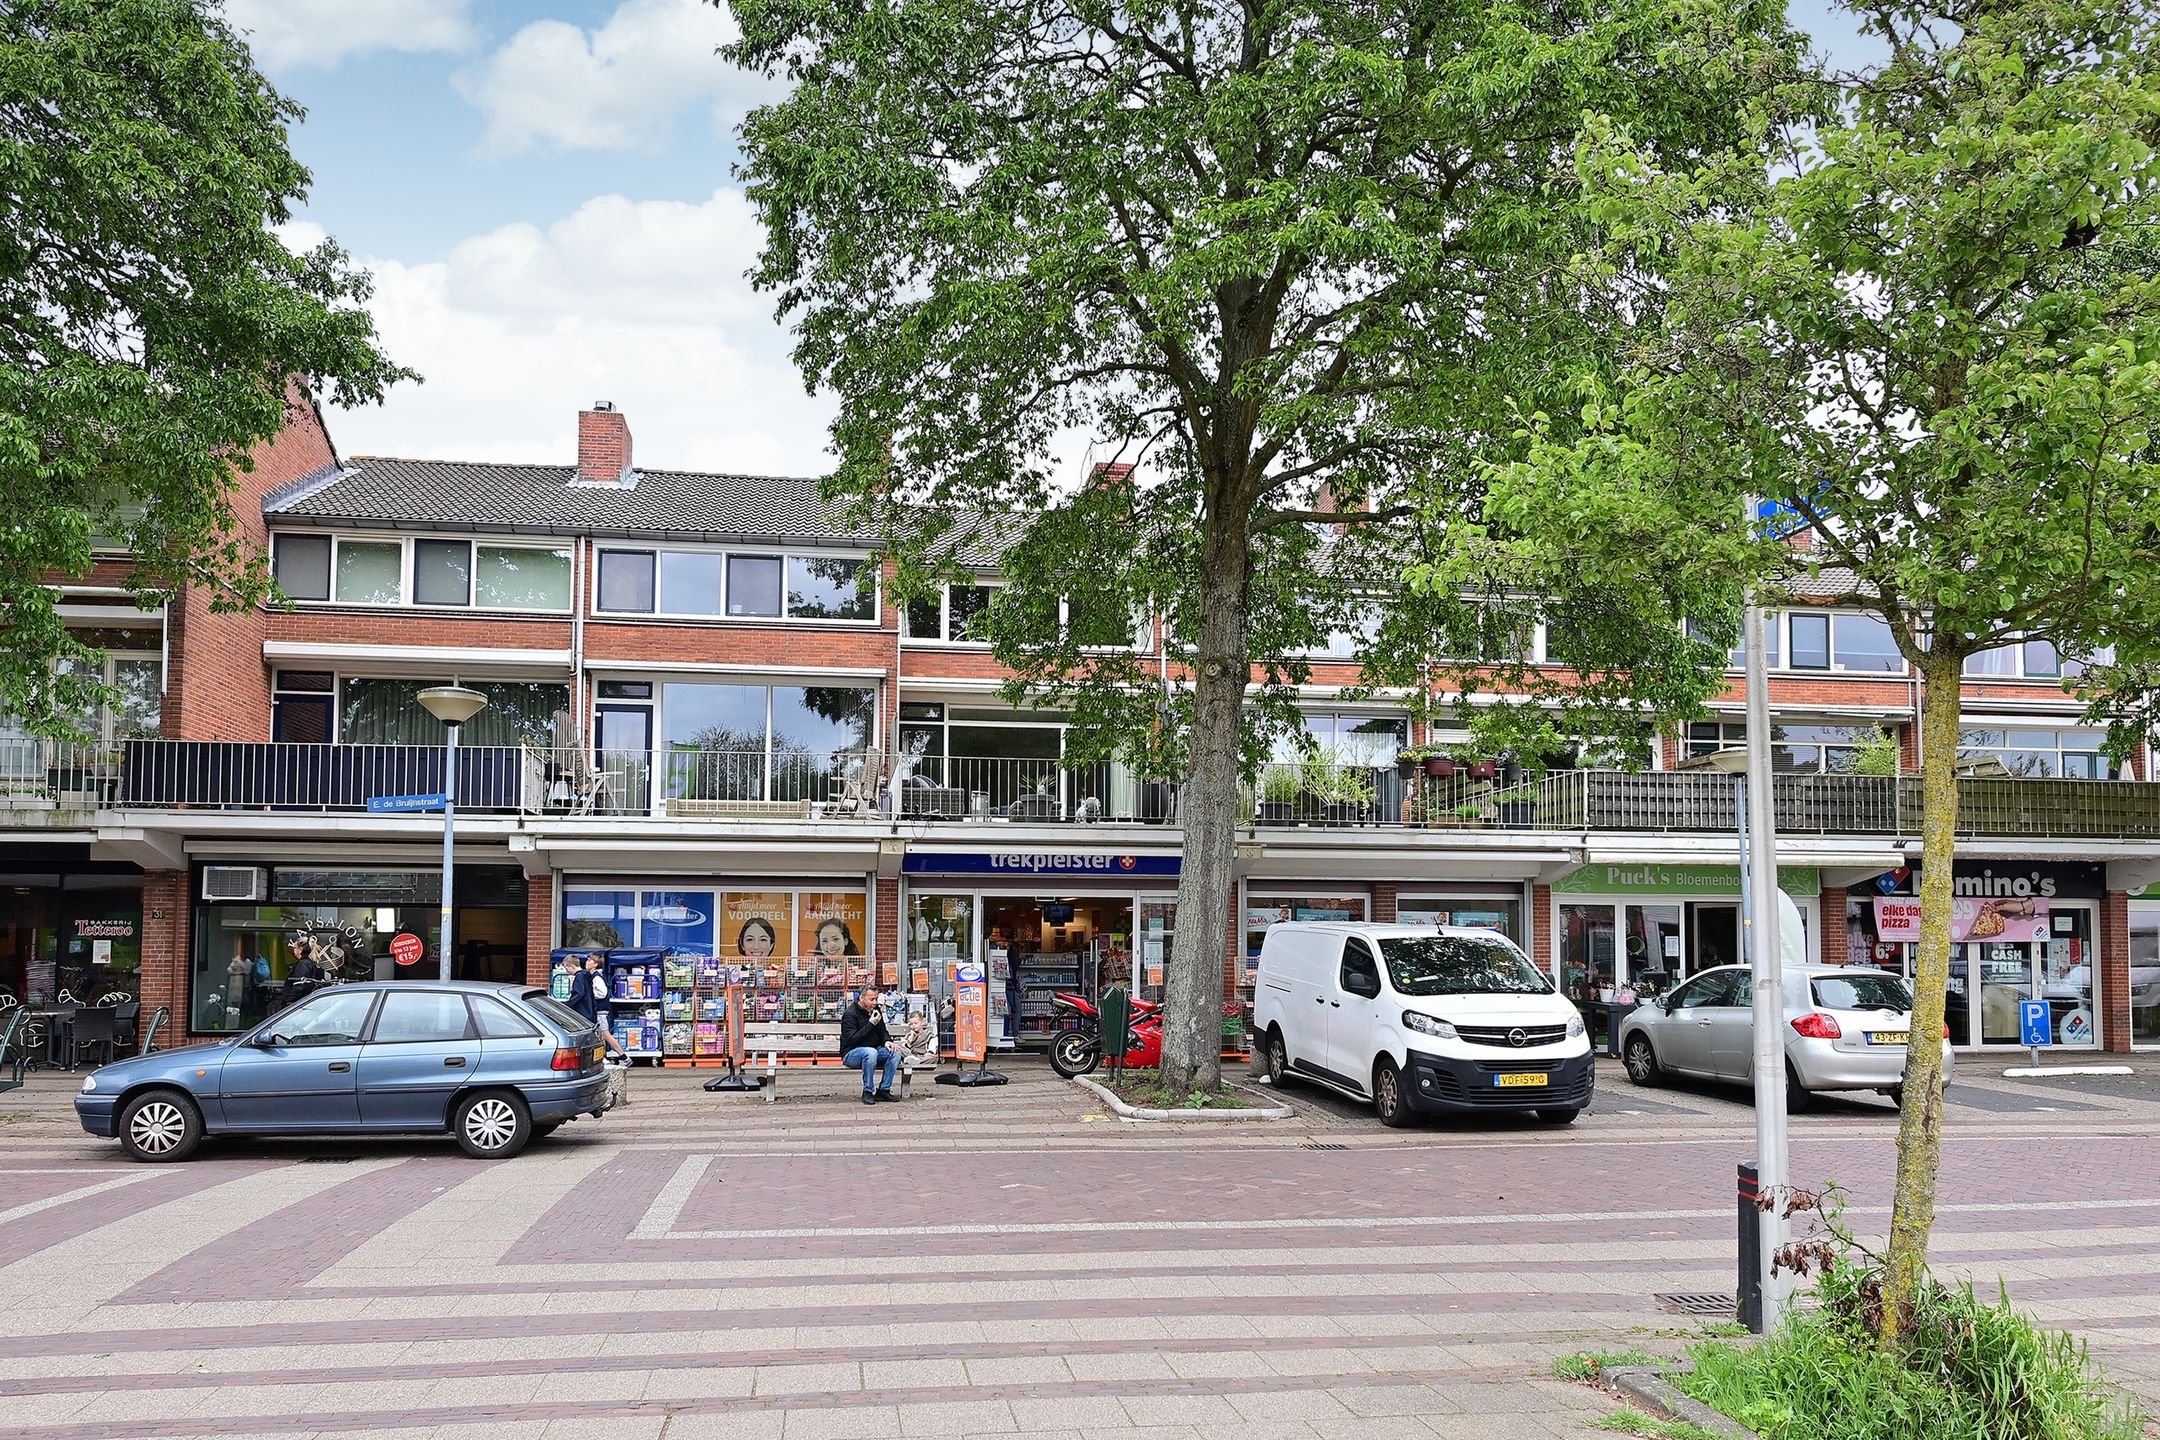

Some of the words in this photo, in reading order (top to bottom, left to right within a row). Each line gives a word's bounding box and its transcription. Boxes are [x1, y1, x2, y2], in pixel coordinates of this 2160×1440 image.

[383, 800, 394, 808] de
[395, 798, 439, 808] Bruijnstraat
[989, 854, 1115, 872] trekpleister
[1607, 866, 1670, 885] Puck's
[1676, 873, 1740, 886] Bloemenbo
[1912, 869, 2057, 897] mino's
[759, 902, 778, 910] meer
[1882, 905, 1905, 917] elke
[728, 910, 787, 921] VOORDEEL
[804, 910, 863, 921] AANDACHT
[75, 919, 133, 937] Tetteroo
[1881, 916, 1910, 930] pizza
[288, 916, 365, 950] KAPSALON
[1990, 950, 2022, 960] CASH
[1991, 961, 2022, 973] FREE
[959, 987, 980, 1002] actie
[2026, 1004, 2044, 1026] P
